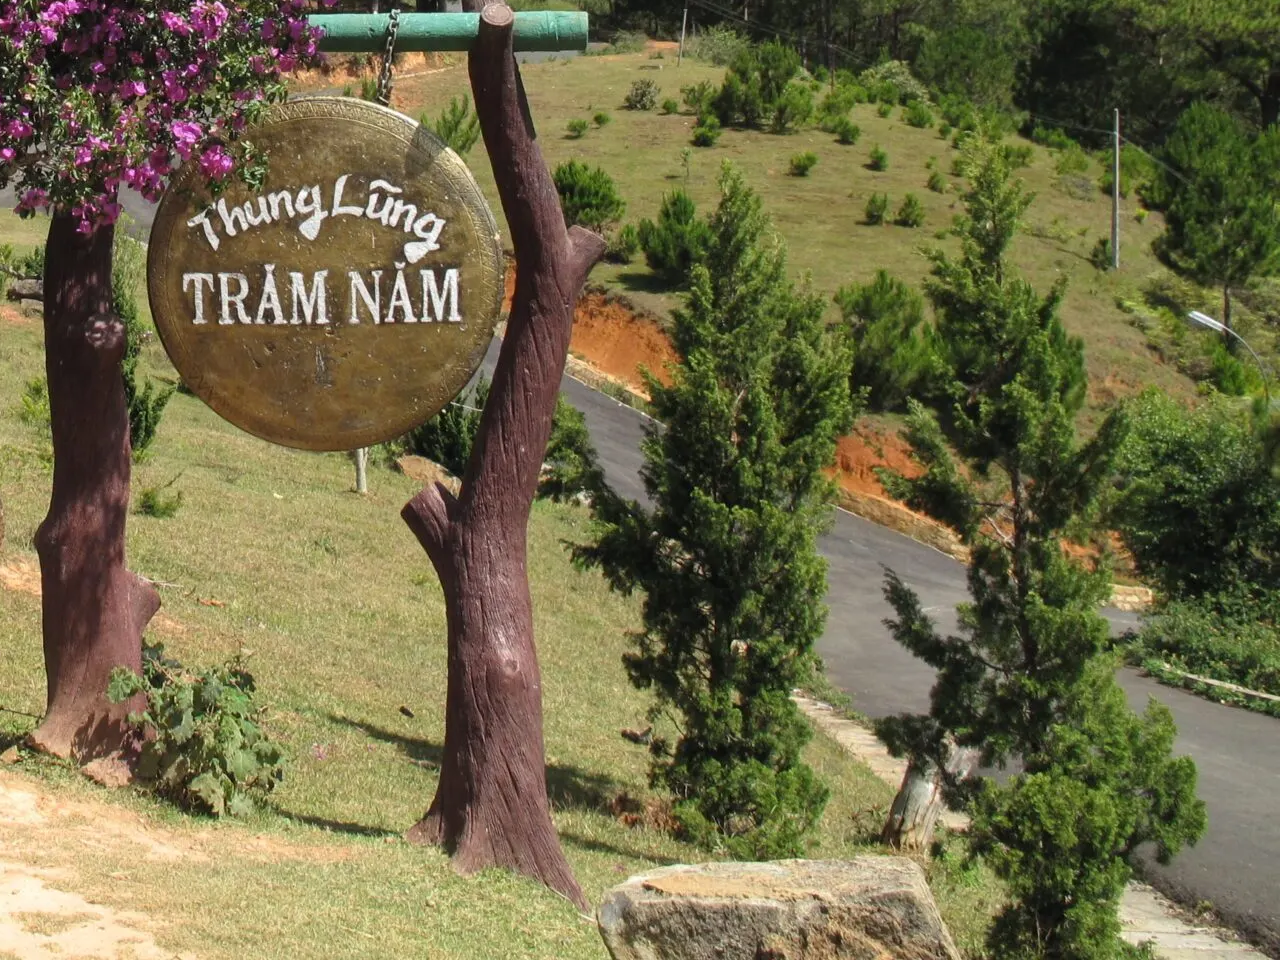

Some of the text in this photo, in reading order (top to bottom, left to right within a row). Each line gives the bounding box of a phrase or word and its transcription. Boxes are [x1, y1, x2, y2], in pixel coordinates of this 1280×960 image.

[187, 174, 447, 264] Thung Lũng
[182, 261, 462, 325] TRĂM NĂM
